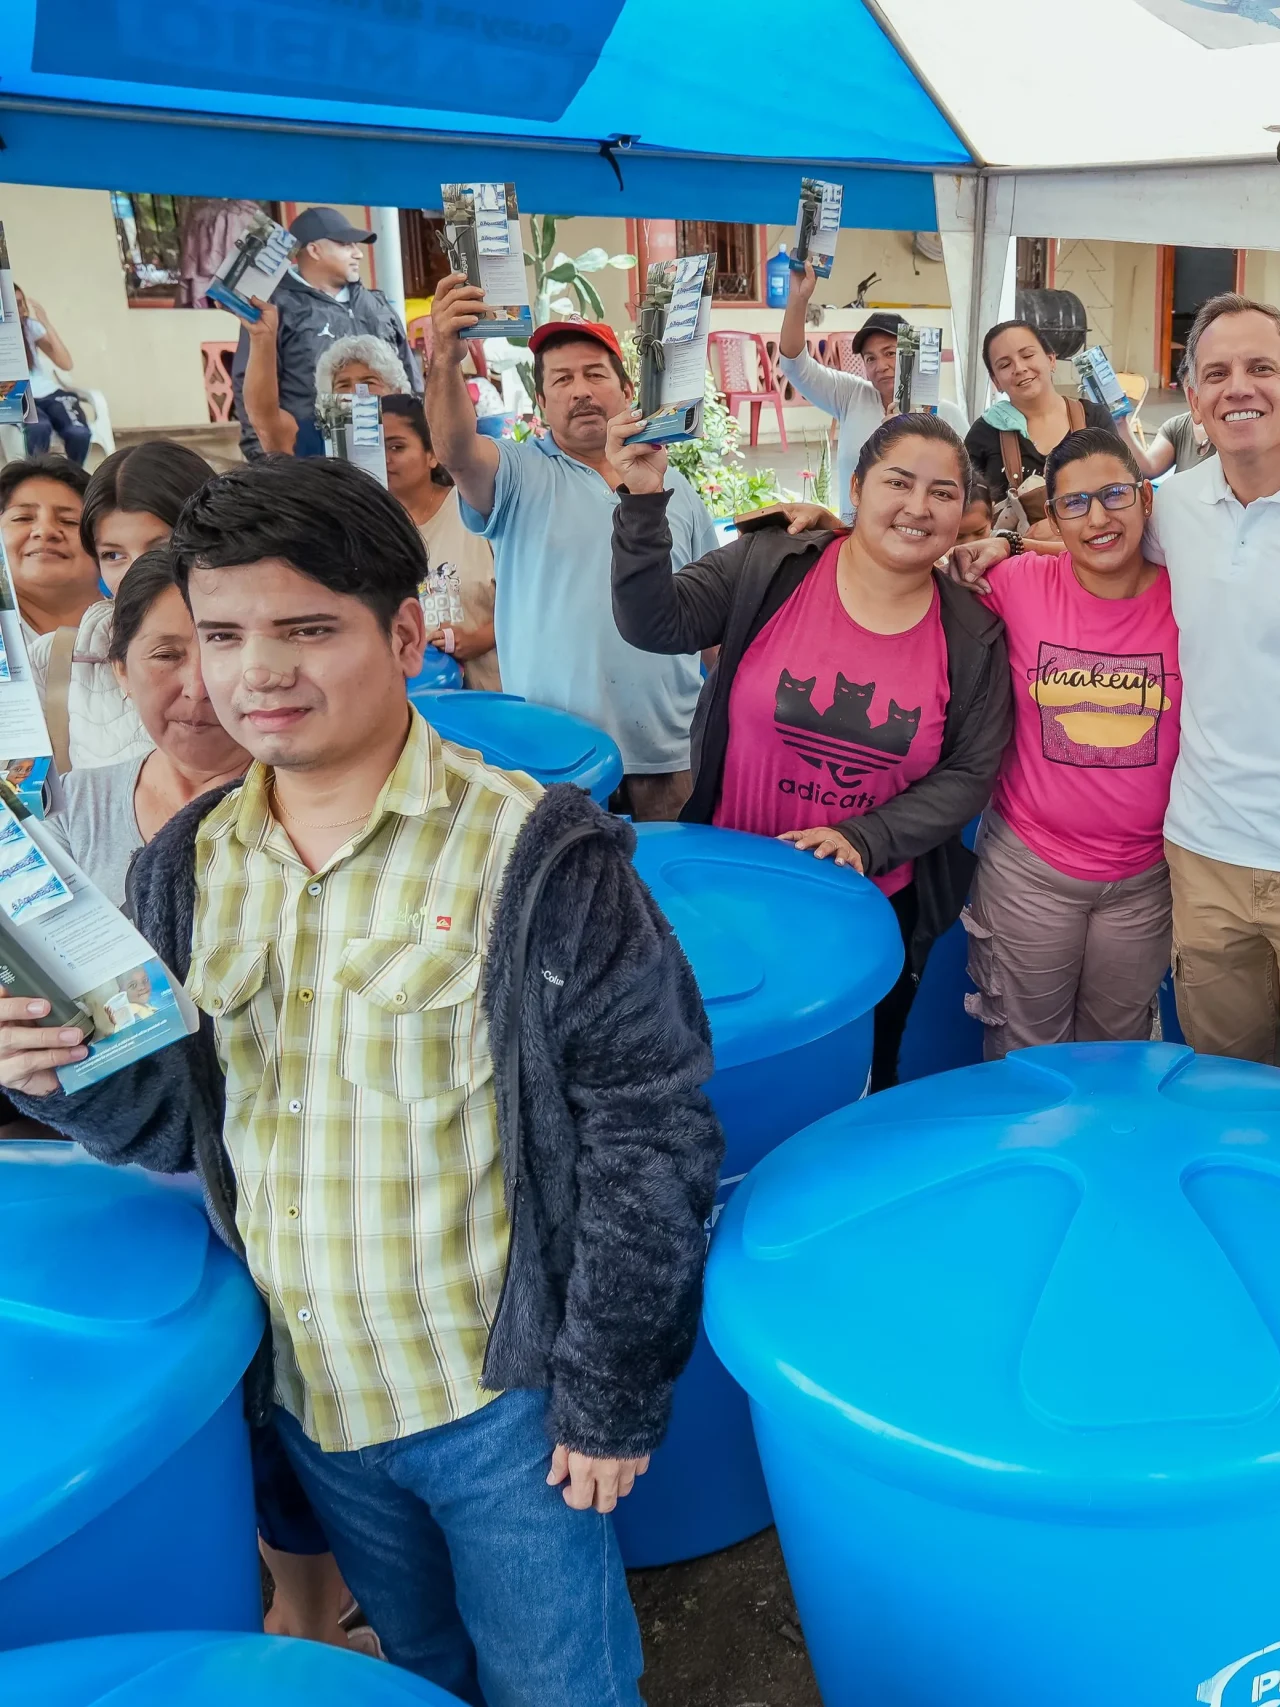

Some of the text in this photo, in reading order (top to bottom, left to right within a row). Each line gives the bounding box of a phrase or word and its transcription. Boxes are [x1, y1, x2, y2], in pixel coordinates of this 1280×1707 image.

[1028, 657, 1179, 715] makeup
[778, 779, 877, 809] adicats
[543, 970, 565, 987] Colum
